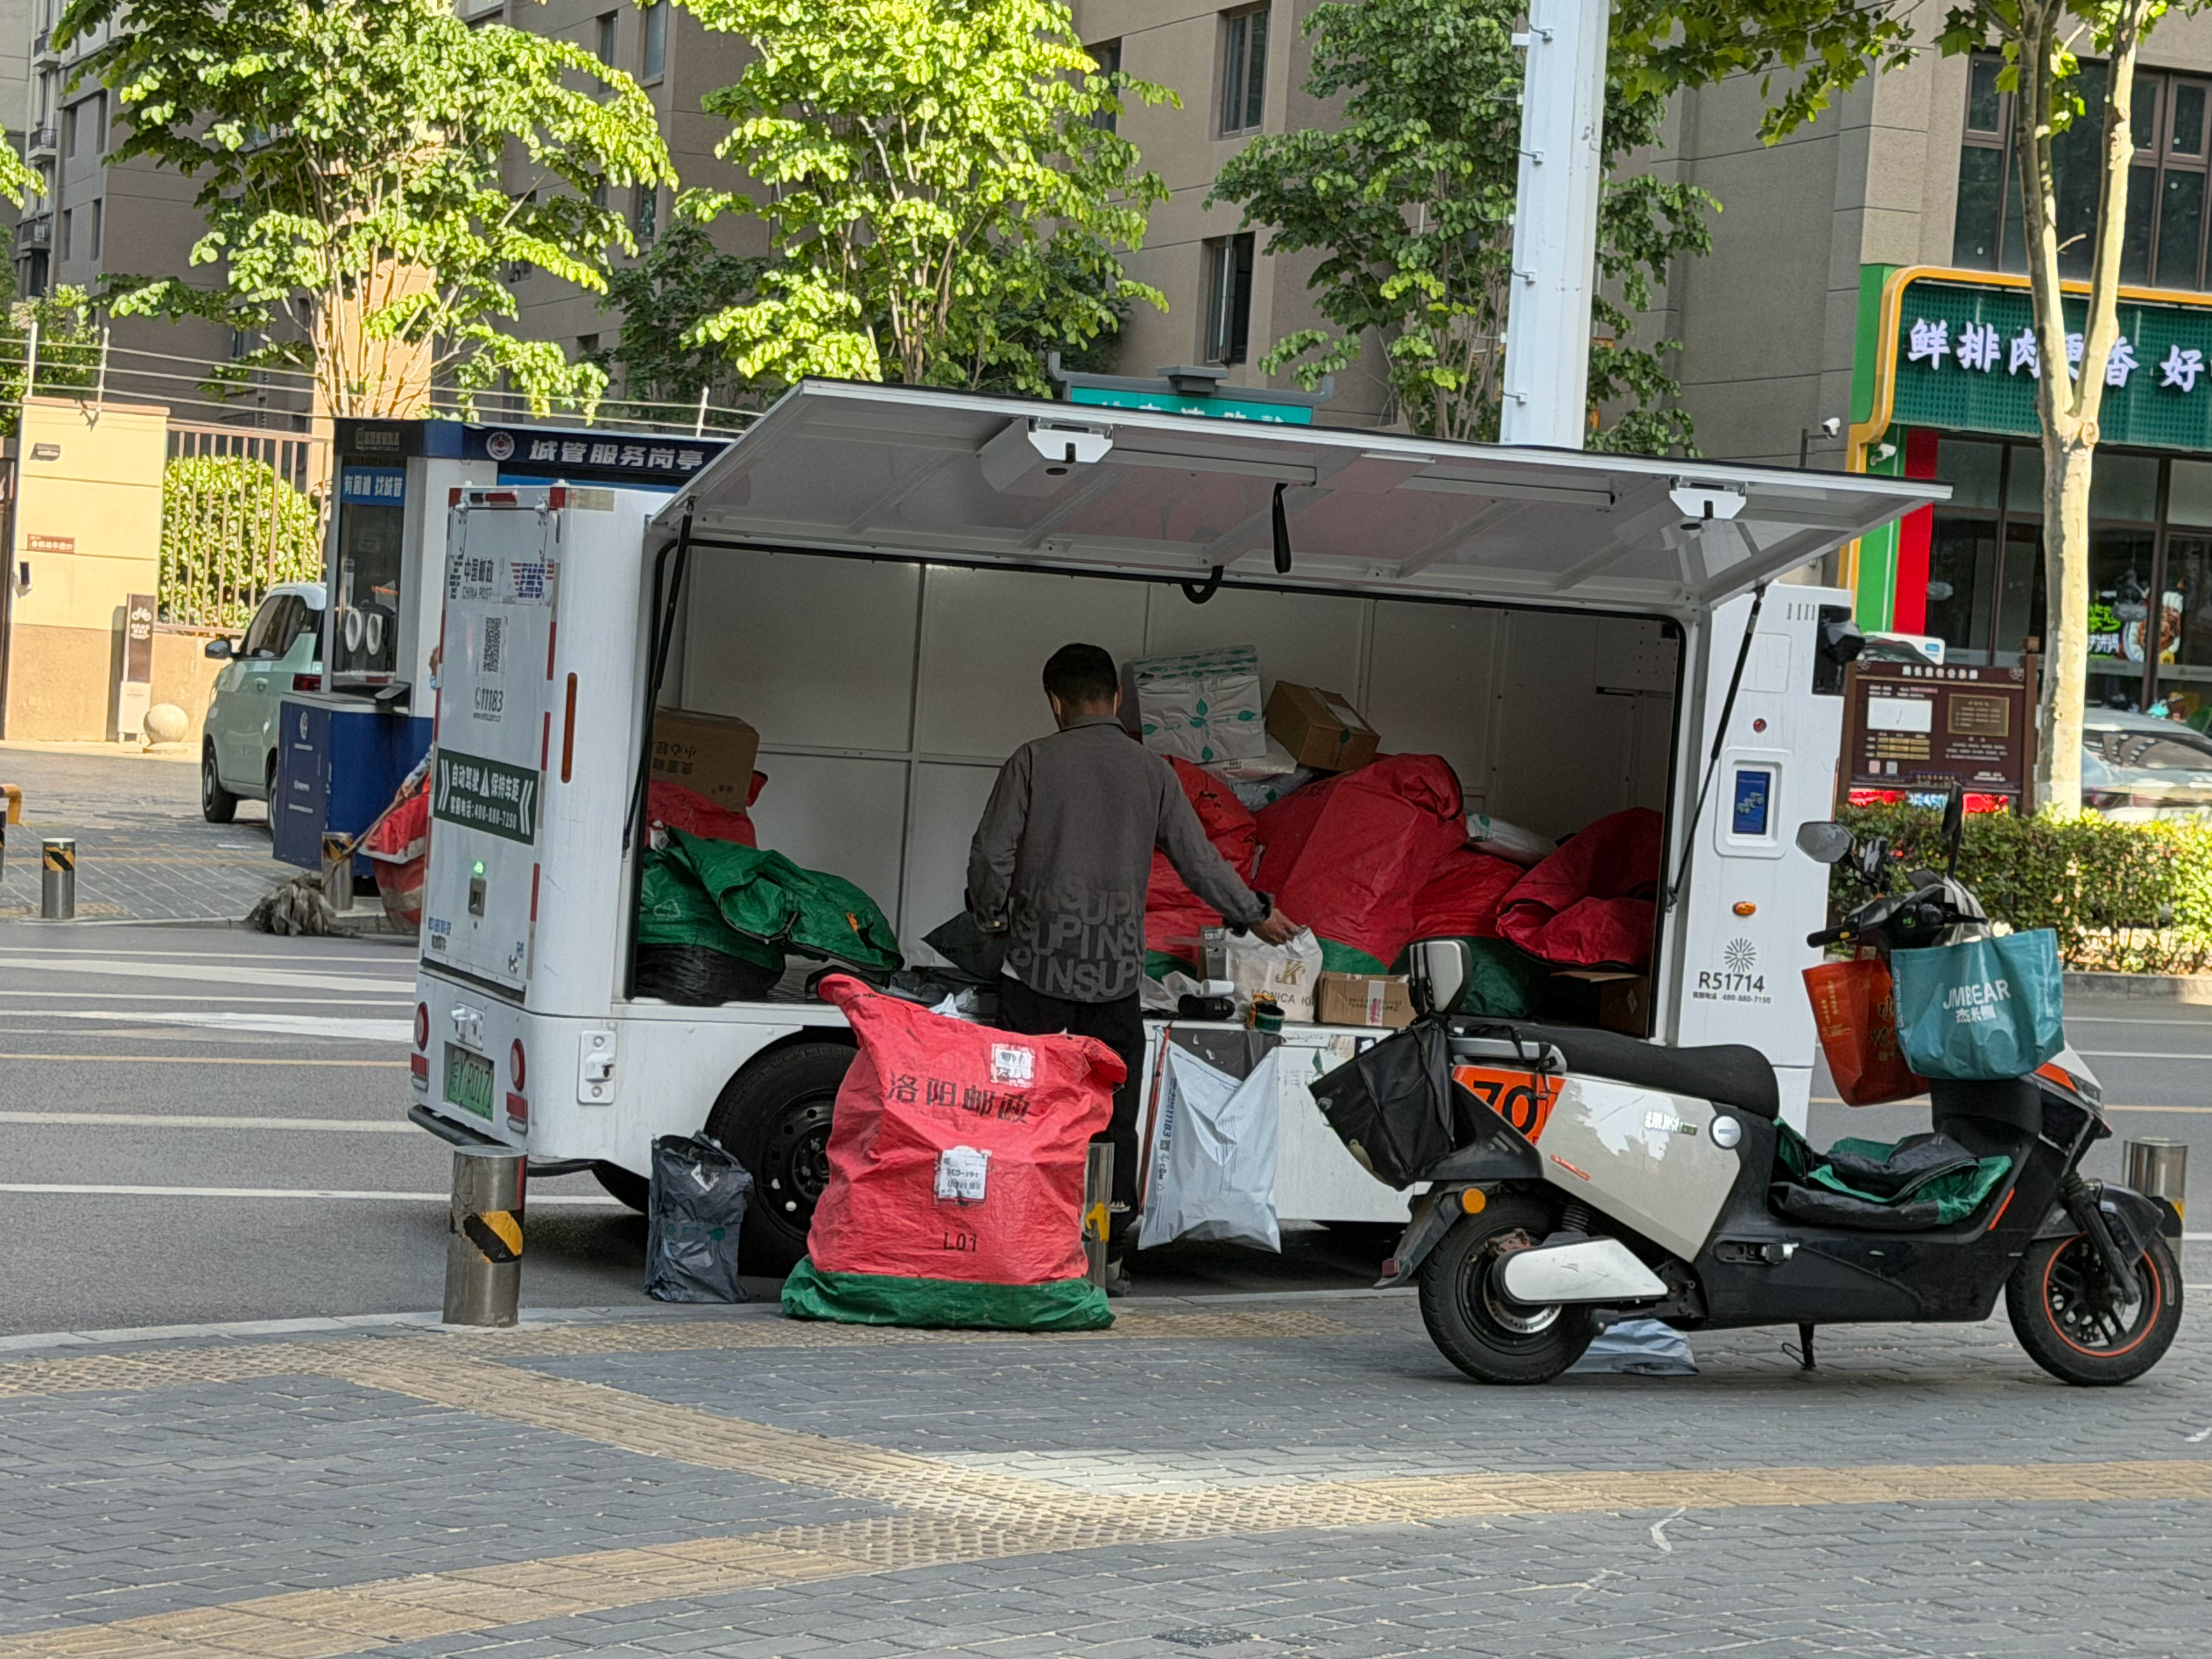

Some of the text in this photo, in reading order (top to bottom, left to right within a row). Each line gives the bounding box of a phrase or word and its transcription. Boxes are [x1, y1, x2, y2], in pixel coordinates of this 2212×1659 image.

[2160, 345, 2211, 392] 好
[528, 439, 705, 471] 城管服务岗亭
[464, 556, 494, 583] 中国邮政
[481, 687, 504, 713] 11183
[452, 762, 520, 803] 自动驾驶 保持车距
[1699, 970, 1765, 993] R51714
[1943, 979, 2011, 1010] JMBEAR
[887, 1069, 1030, 1125] 洛阳邮政
[1163, 1109, 1175, 1138] 11183
